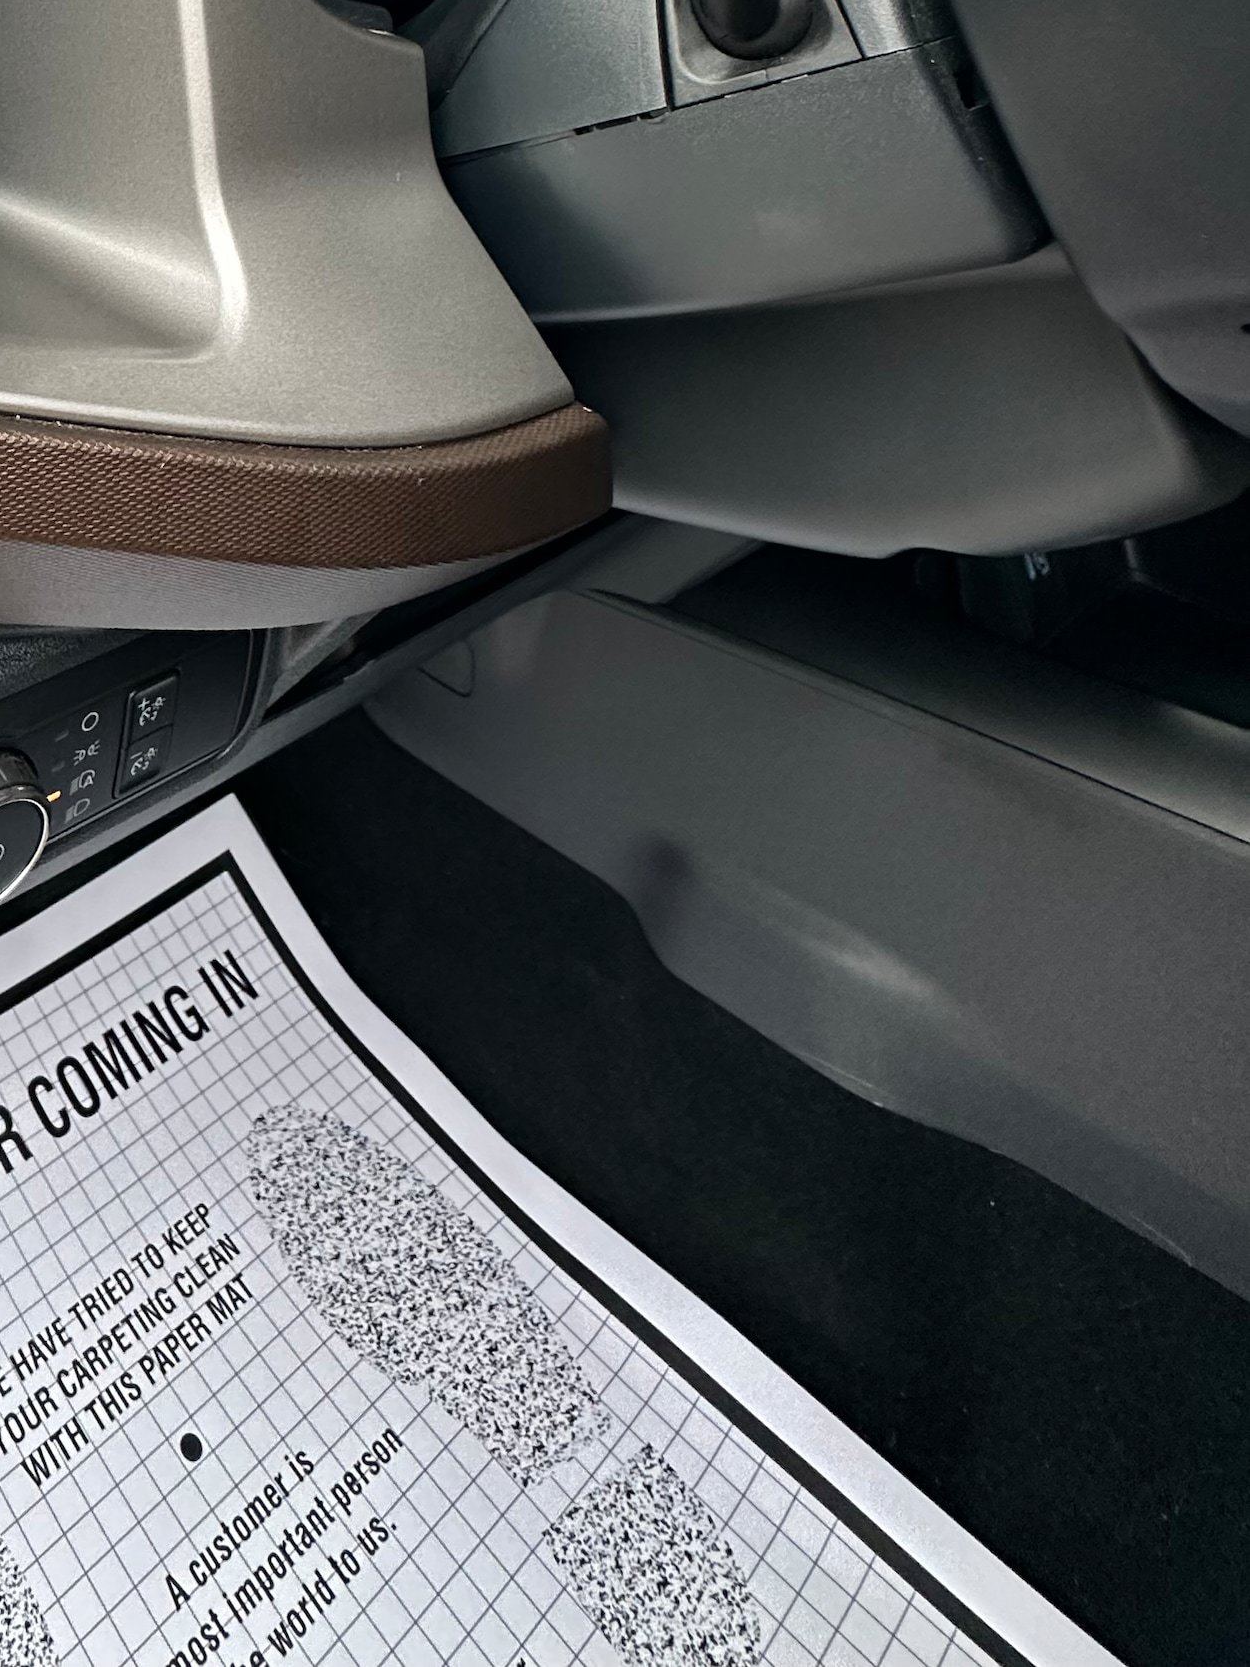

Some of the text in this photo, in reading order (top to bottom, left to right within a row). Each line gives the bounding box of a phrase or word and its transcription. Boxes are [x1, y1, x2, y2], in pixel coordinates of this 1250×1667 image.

[26, 984, 210, 1138] COMING
[197, 948, 260, 1019] IN
[9, 1317, 73, 1381] HAVE
[67, 1267, 135, 1331] TRIED
[130, 1242, 165, 1279] TO
[161, 1202, 212, 1256] KEEP
[19, 1272, 255, 1488] WITH THIS PAPER MAT
[55, 1286, 178, 1399] CARPETING
[172, 1232, 241, 1299] CLEAN
[165, 1448, 317, 1612] A customer is
[221, 1495, 336, 1624] important
[331, 1427, 405, 1516] person
[267, 1513, 399, 1658] world to us.
